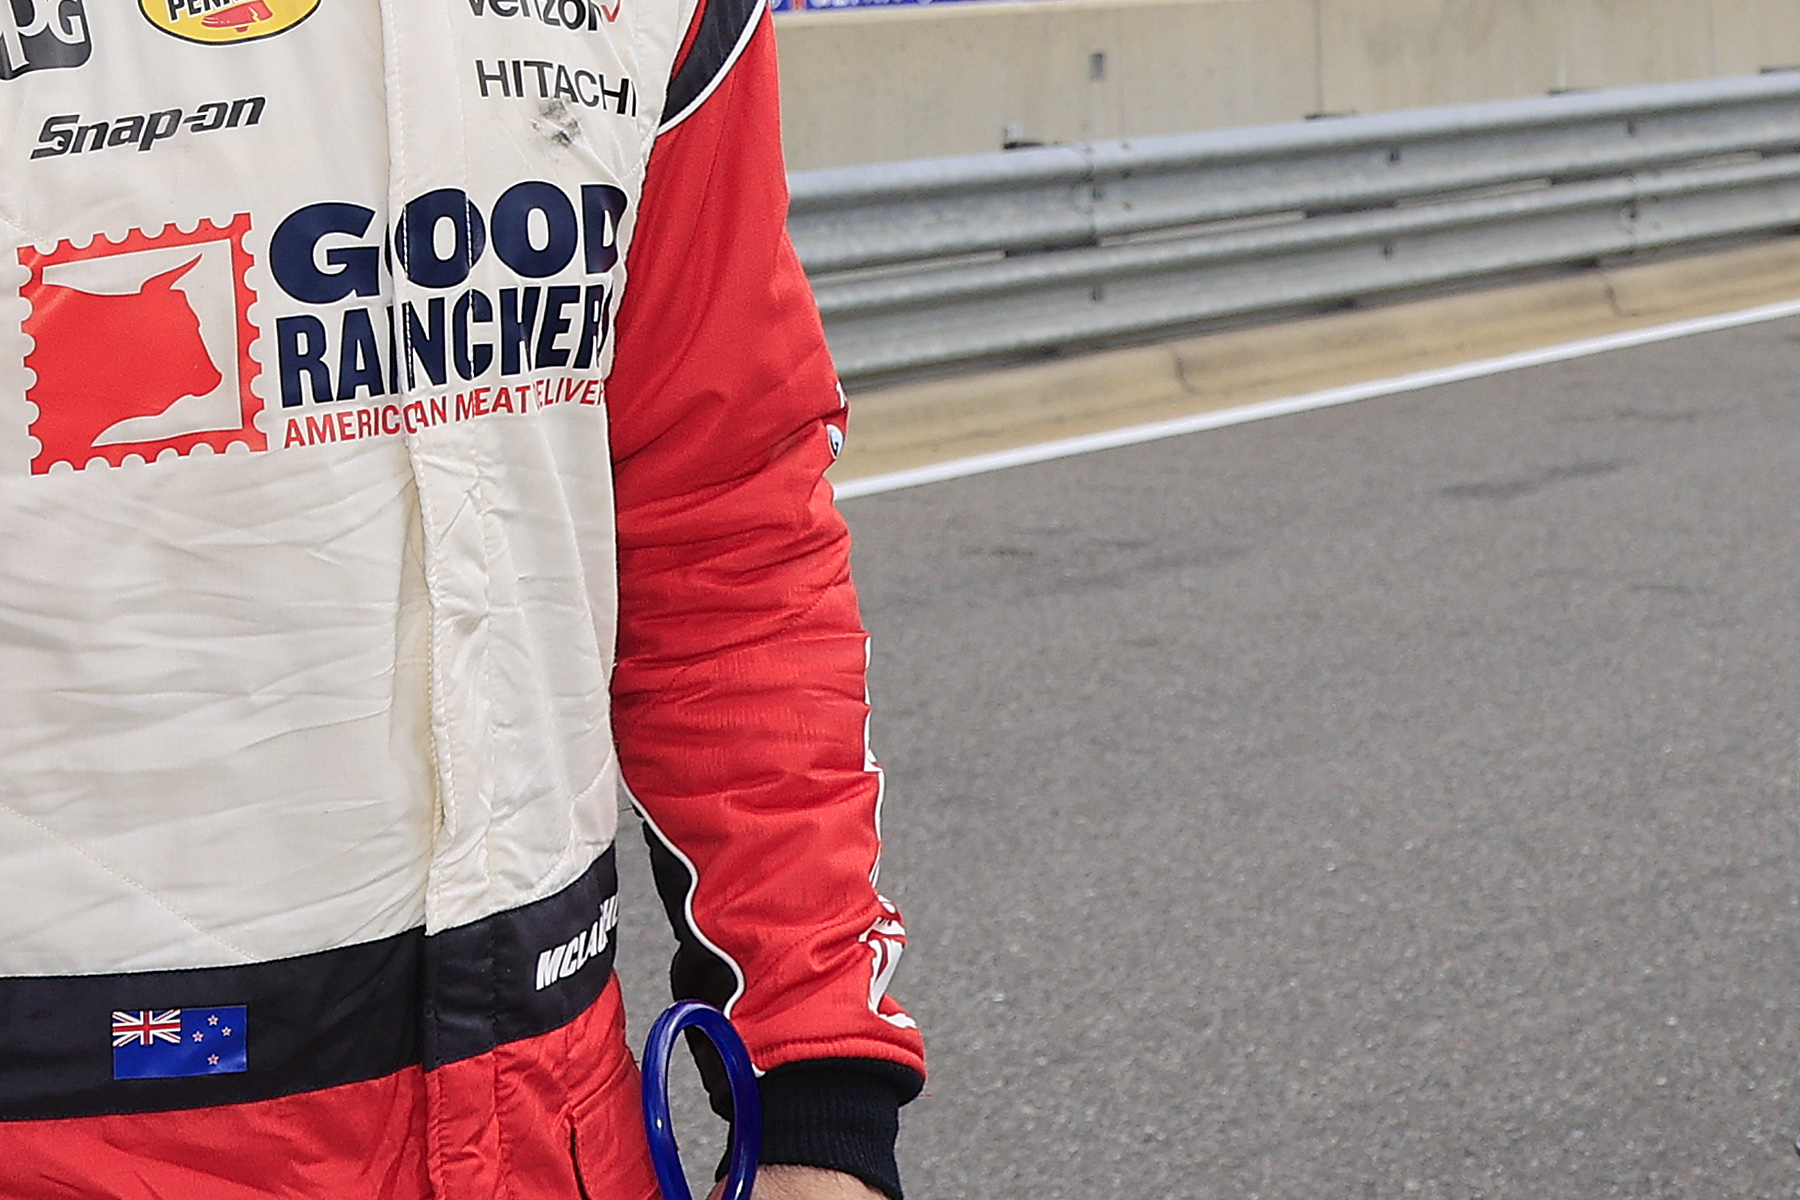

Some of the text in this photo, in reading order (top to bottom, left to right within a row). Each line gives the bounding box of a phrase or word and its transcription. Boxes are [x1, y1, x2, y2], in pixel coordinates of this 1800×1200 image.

[475, 59, 638, 117] HITACHI
[29, 96, 267, 160] Snap-on
[269, 180, 629, 306] GOOD
[455, 384, 531, 422] MEAT
